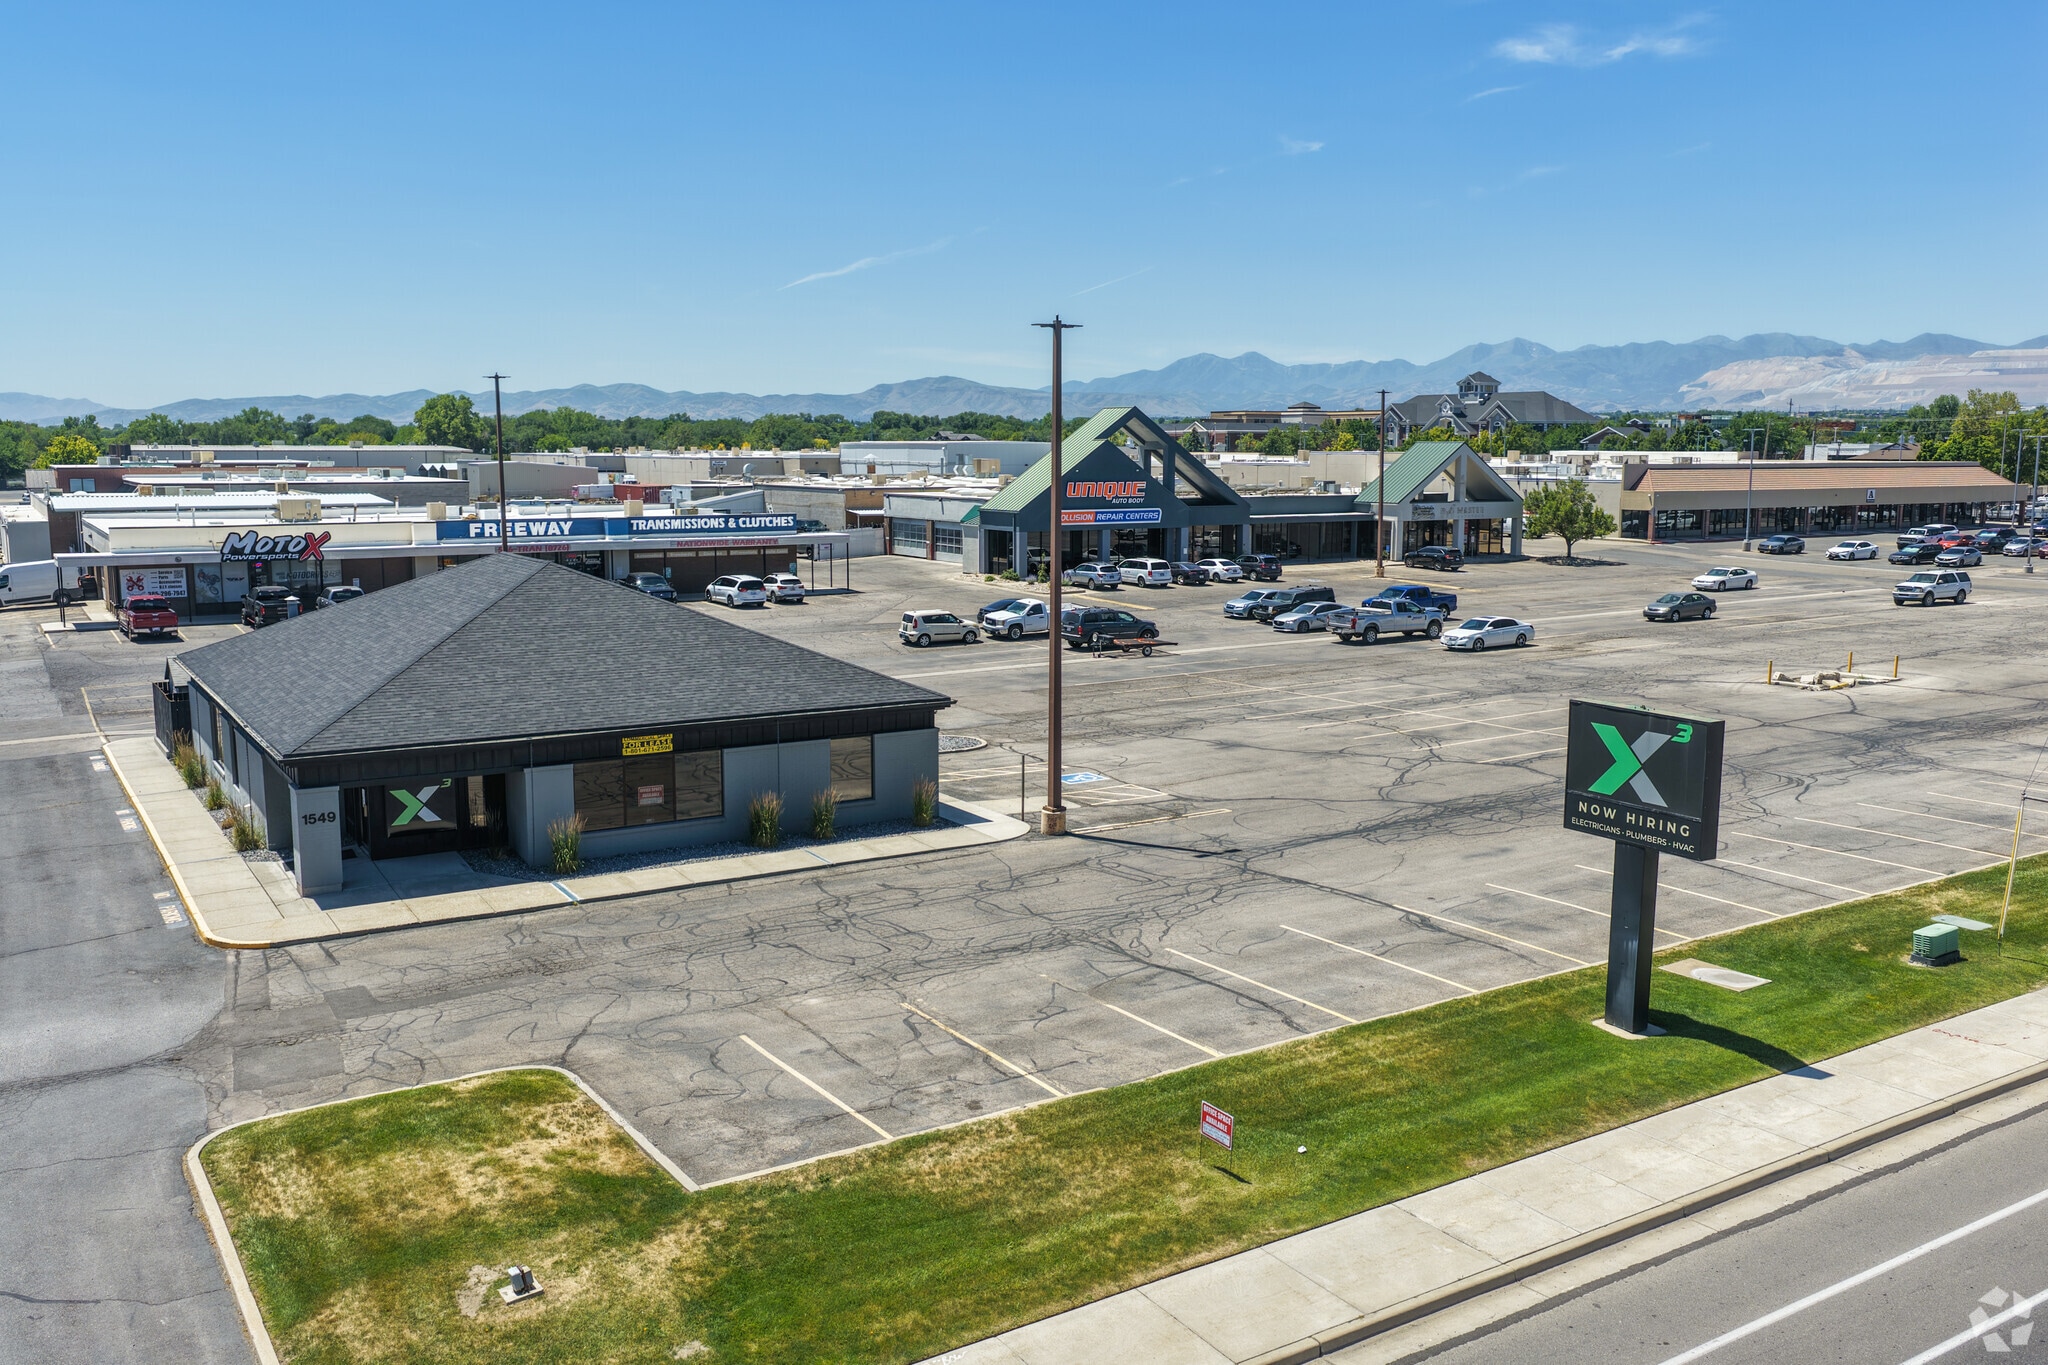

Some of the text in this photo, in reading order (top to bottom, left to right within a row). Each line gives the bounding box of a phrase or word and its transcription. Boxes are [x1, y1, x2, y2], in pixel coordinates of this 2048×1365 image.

[1067, 482, 1146, 500] UNIQUE
[631, 517, 725, 531] TRANSMISSIONS
[728, 517, 737, 528] &
[738, 515, 794, 528] CLUTCHES
[1061, 511, 1159, 522] OLLISION REPAIR CENTERS
[676, 539, 730, 548] NATIONWIDE
[223, 553, 299, 561] Powersports
[624, 739, 672, 749] FOR LEASE
[301, 811, 337, 826] 1549
[1578, 801, 1691, 837] NOW HIRING
[1571, 816, 1695, 853] ELECTRICIANS PLUMBERS HVAC
